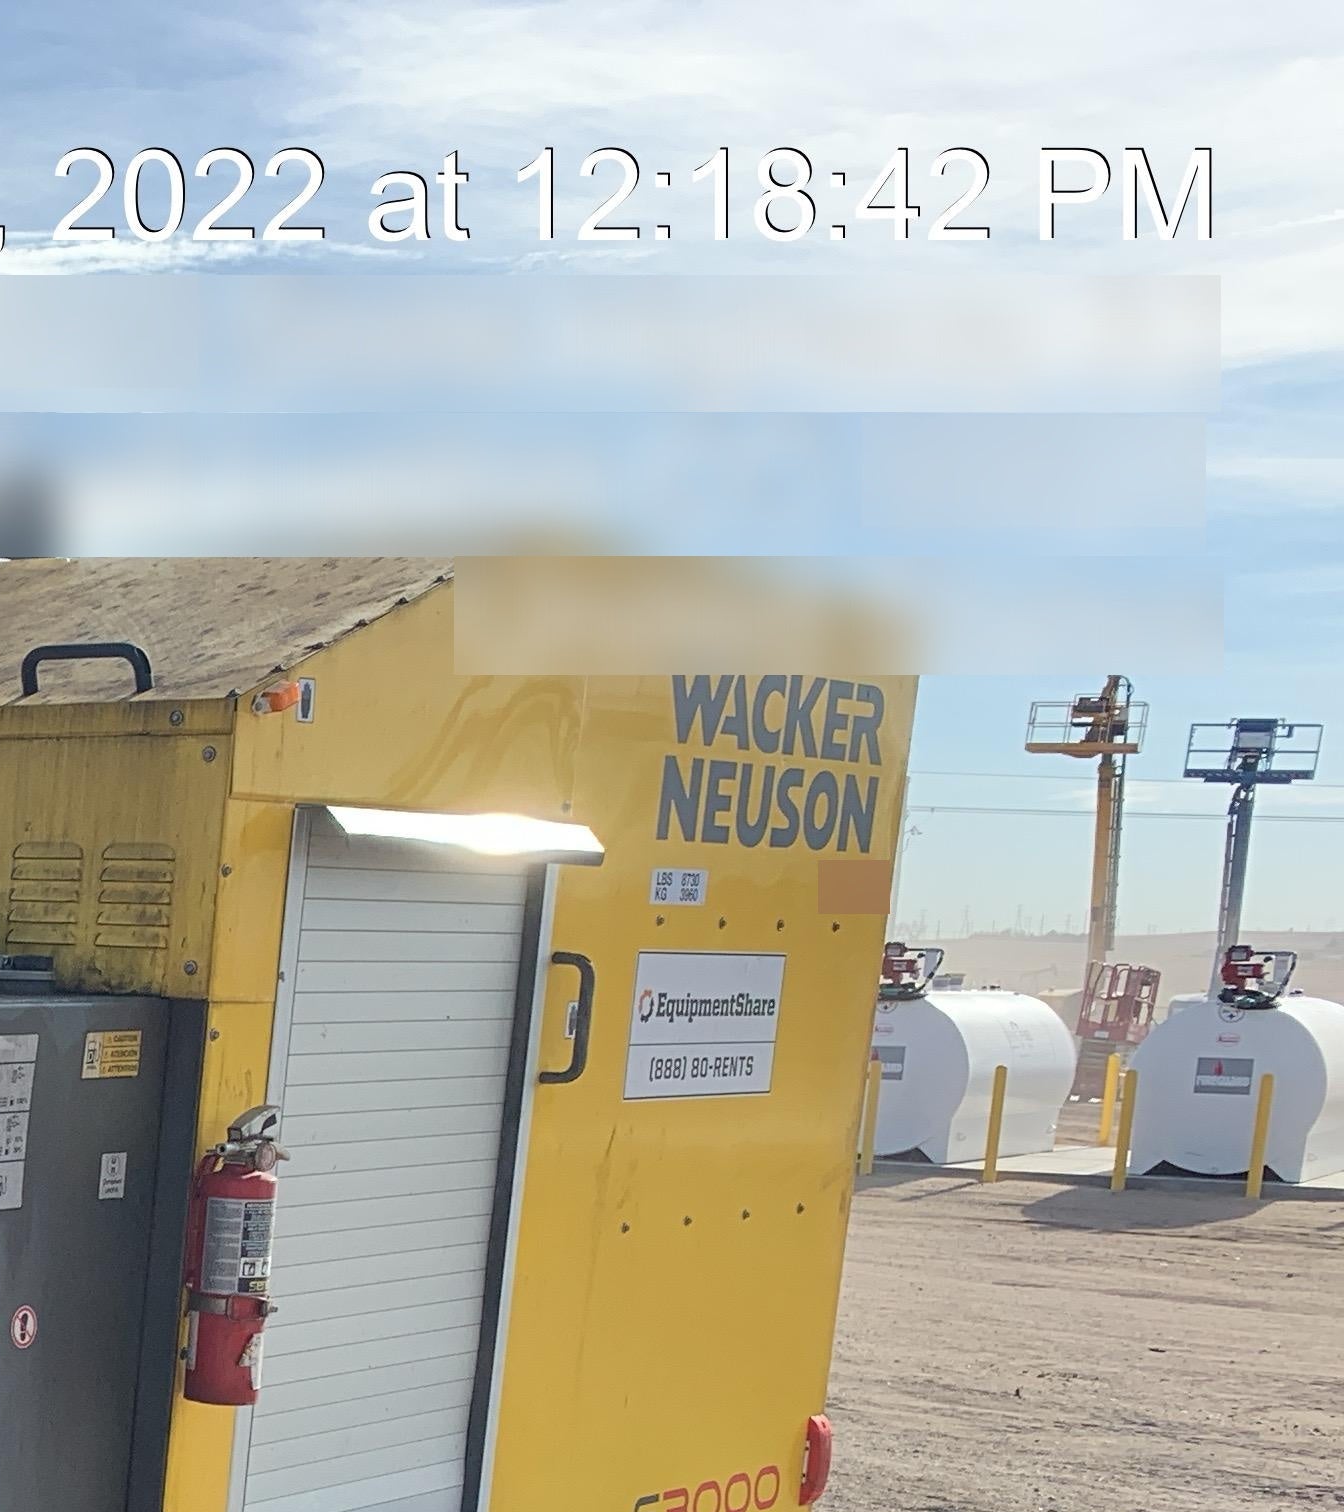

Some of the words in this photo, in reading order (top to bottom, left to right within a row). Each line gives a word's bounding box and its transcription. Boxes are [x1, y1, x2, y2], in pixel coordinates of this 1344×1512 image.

[672, 674, 885, 766] WACKER
[656, 755, 880, 854] NEUSON
[656, 871, 673, 886] LBS
[654, 887, 667, 900] KG
[656, 992, 776, 1023] EquipmentShare
[649, 1056, 687, 1082] (888)
[691, 1056, 754, 1078] 80-RENTS
